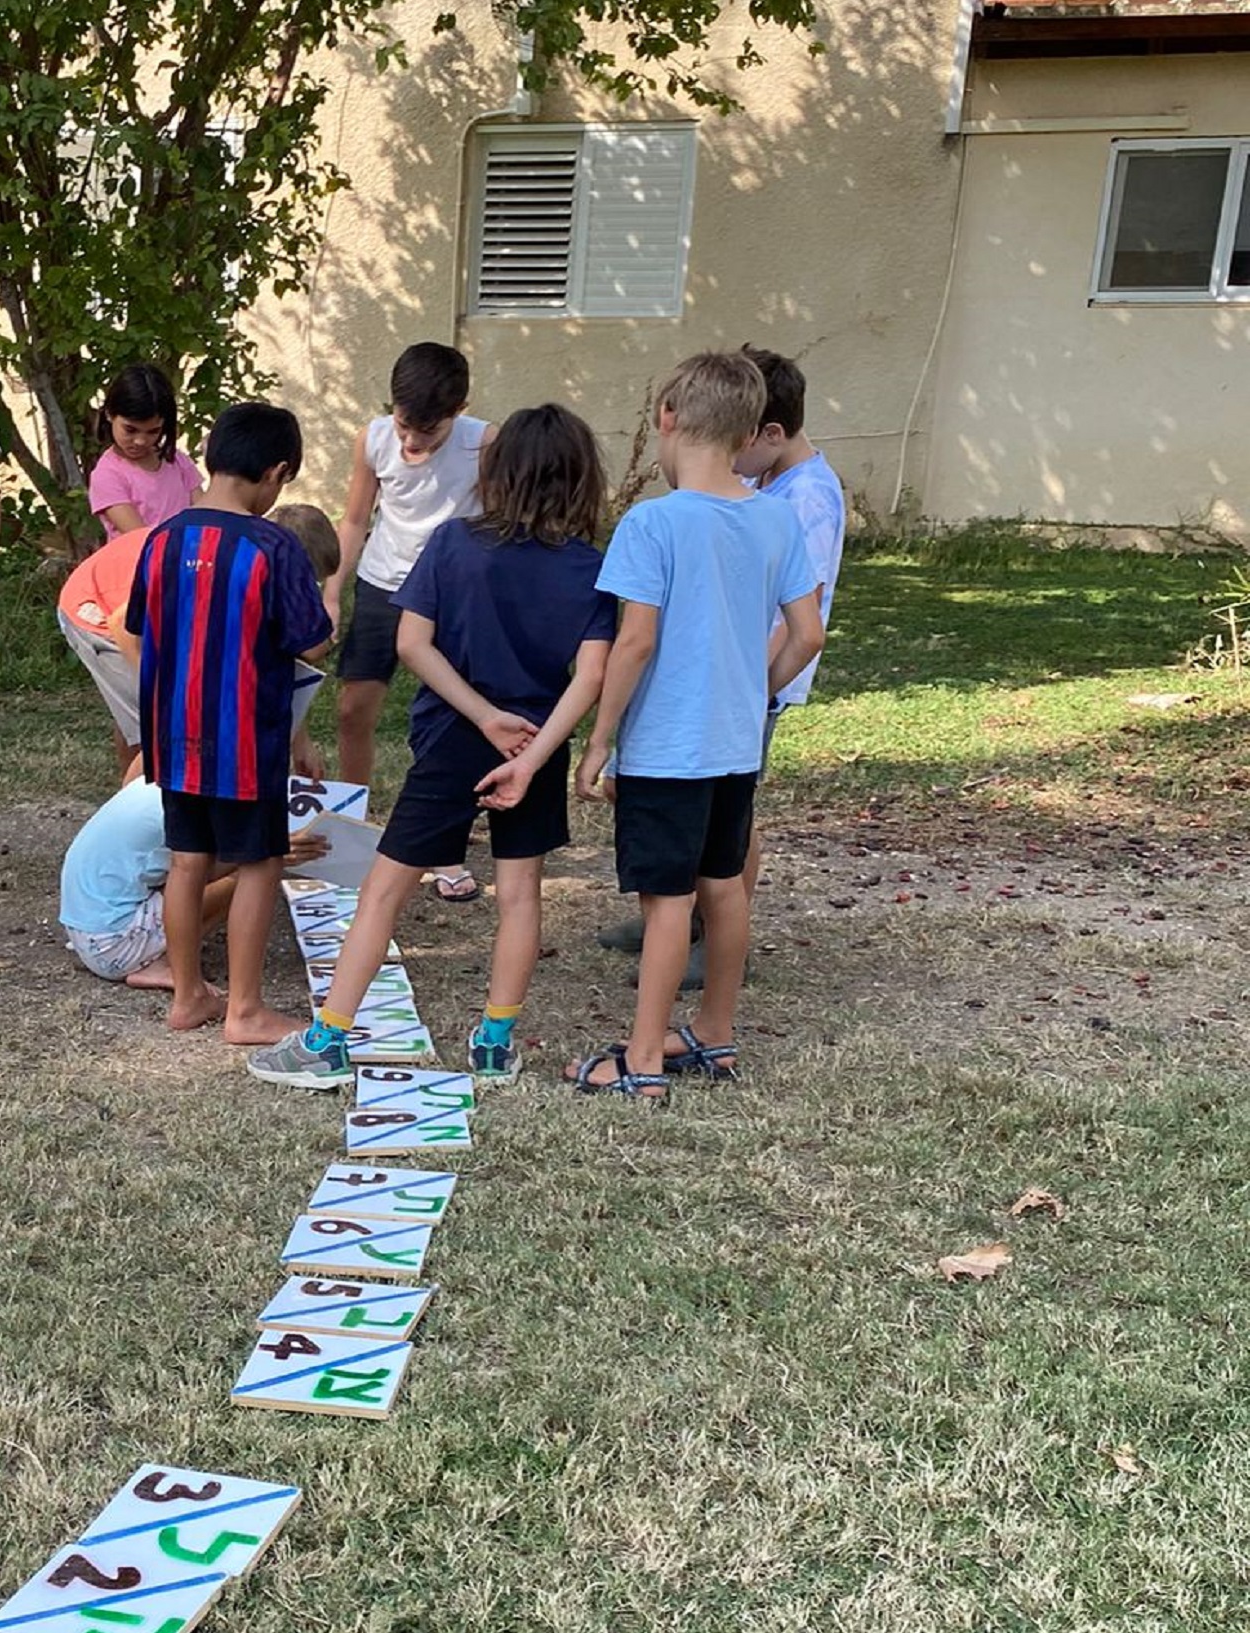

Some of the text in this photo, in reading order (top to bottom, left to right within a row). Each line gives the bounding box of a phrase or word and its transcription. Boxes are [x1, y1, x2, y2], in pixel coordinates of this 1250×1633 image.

[361, 1069, 414, 1082] 9
[349, 1113, 418, 1128] 8
[326, 1173, 388, 1187] 7
[310, 1219, 372, 1236] 6
[300, 1280, 363, 1298] 5
[258, 1333, 322, 1360] 4
[133, 1471, 223, 1502] 3
[47, 1553, 142, 1590] 2
